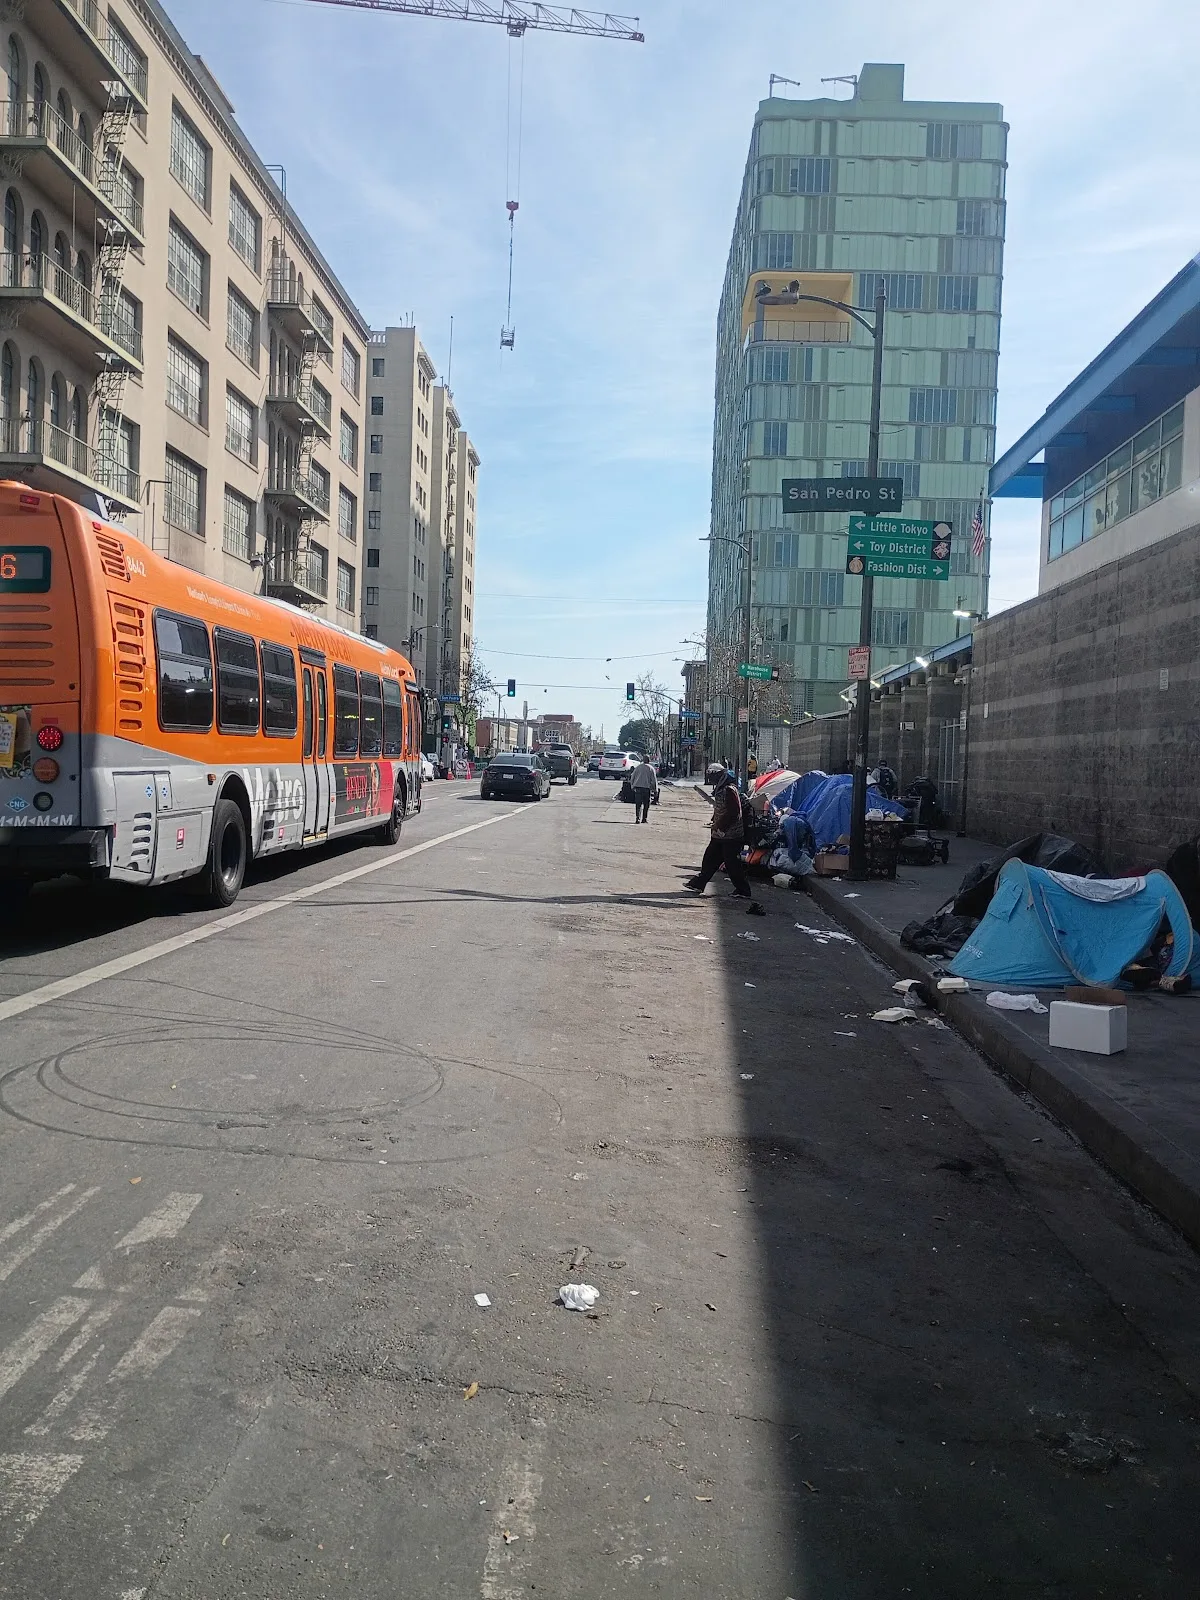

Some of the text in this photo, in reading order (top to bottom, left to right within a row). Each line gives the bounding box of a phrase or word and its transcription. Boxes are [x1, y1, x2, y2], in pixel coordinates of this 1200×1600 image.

[789, 486, 896, 500] San Pedro St
[870, 521, 928, 536] Little Tokyo
[869, 541, 927, 555] Toy District
[126, 556, 147, 578] 8642
[867, 561, 927, 575] Fashion Dist
